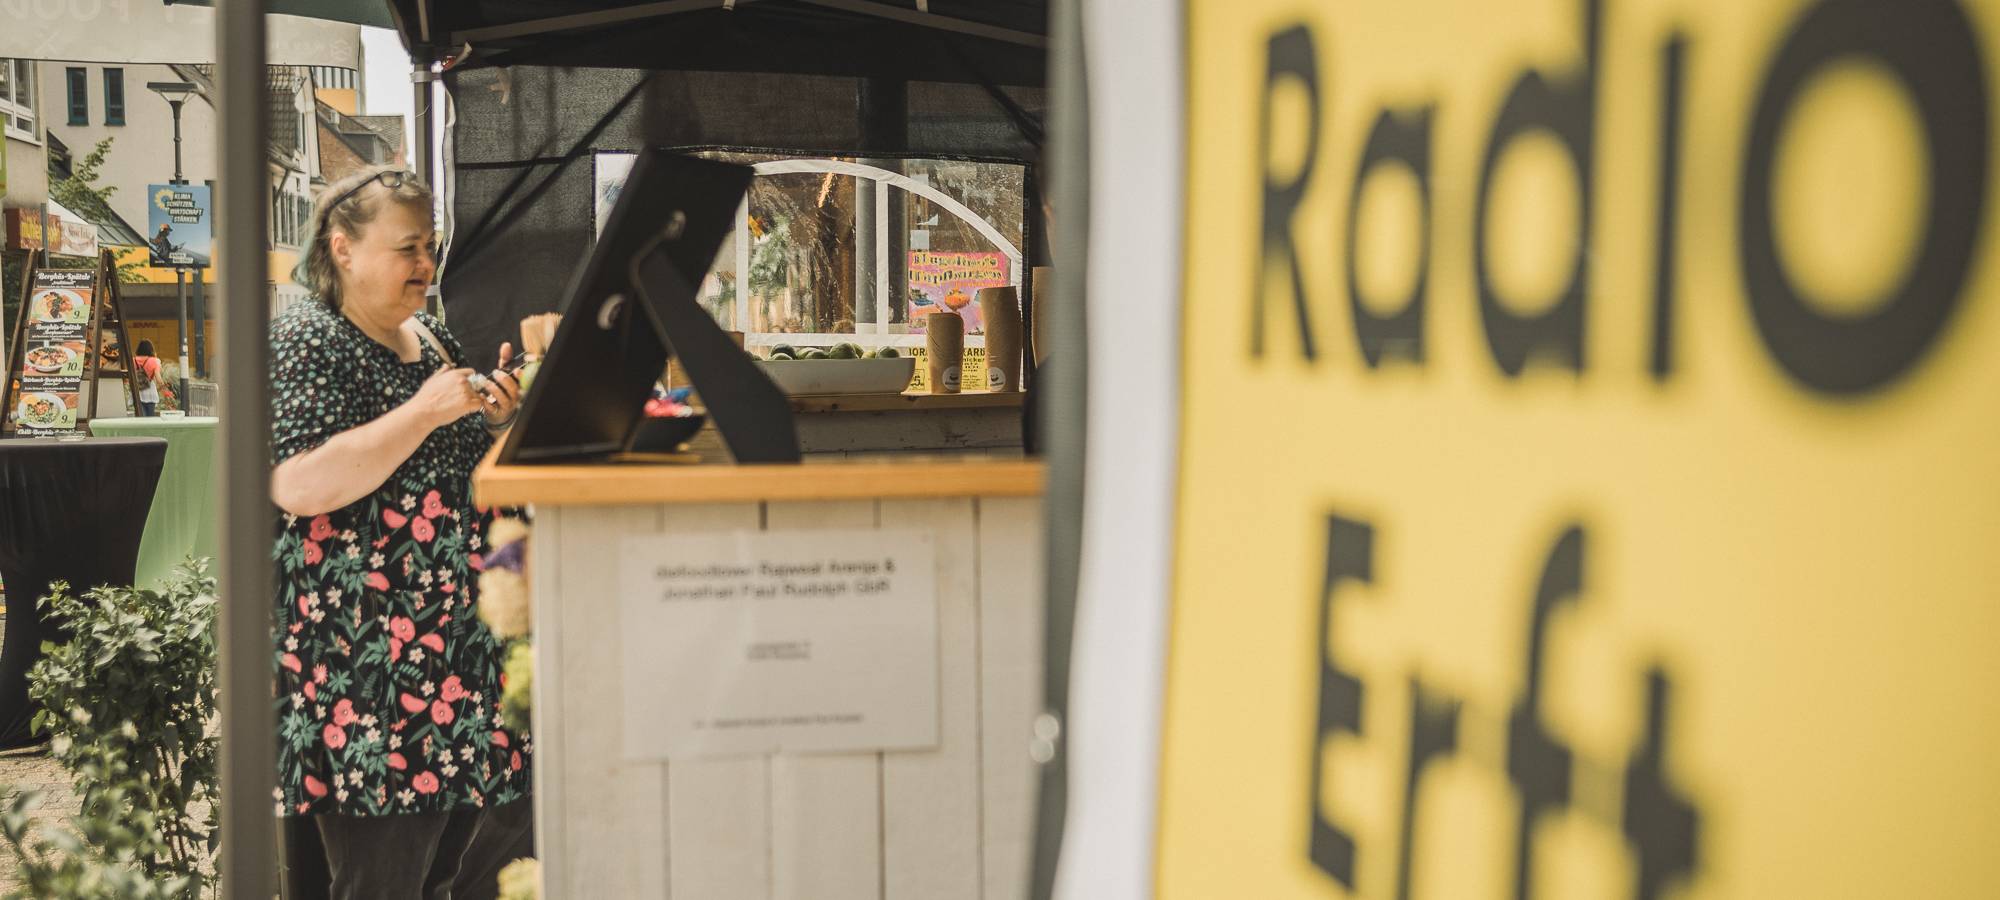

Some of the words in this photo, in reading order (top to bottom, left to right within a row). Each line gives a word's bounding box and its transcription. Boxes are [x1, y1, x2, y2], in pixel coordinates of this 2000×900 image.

[170, 208, 202, 216] WIRTSCHAFT
[1251, 0, 1988, 402] Radio
[1308, 510, 1702, 900] Erft
